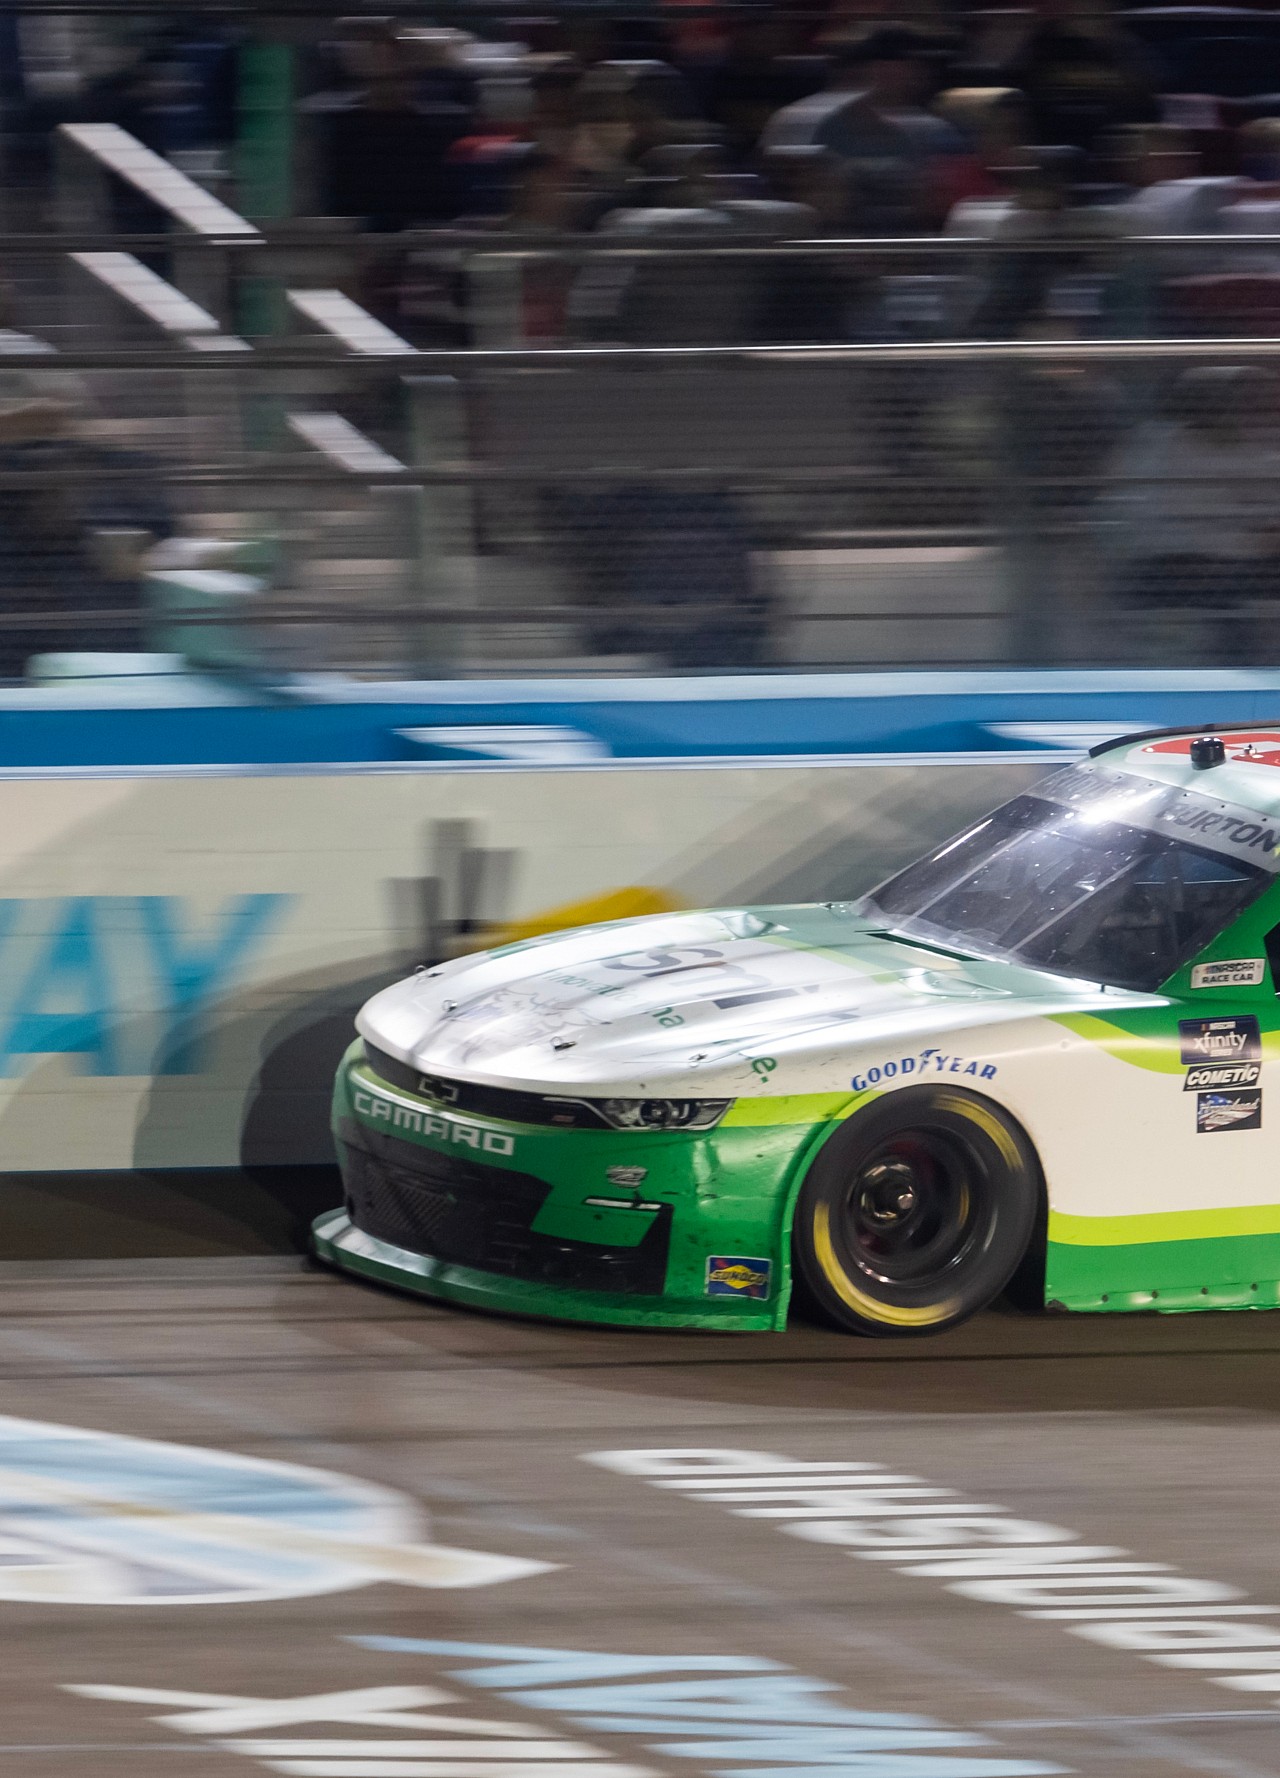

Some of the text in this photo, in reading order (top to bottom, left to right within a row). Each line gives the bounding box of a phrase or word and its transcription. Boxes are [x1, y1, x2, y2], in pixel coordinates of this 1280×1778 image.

[0, 893, 300, 1079] AY
[1202, 973, 1254, 984] RACE CAR
[1193, 1031, 1247, 1054] xfinity
[851, 1051, 998, 1092] GOODYEAR
[1186, 1064, 1260, 1086] COMETIC
[353, 1092, 515, 1156] CAMARO
[711, 1270, 768, 1284] SUNOCO
